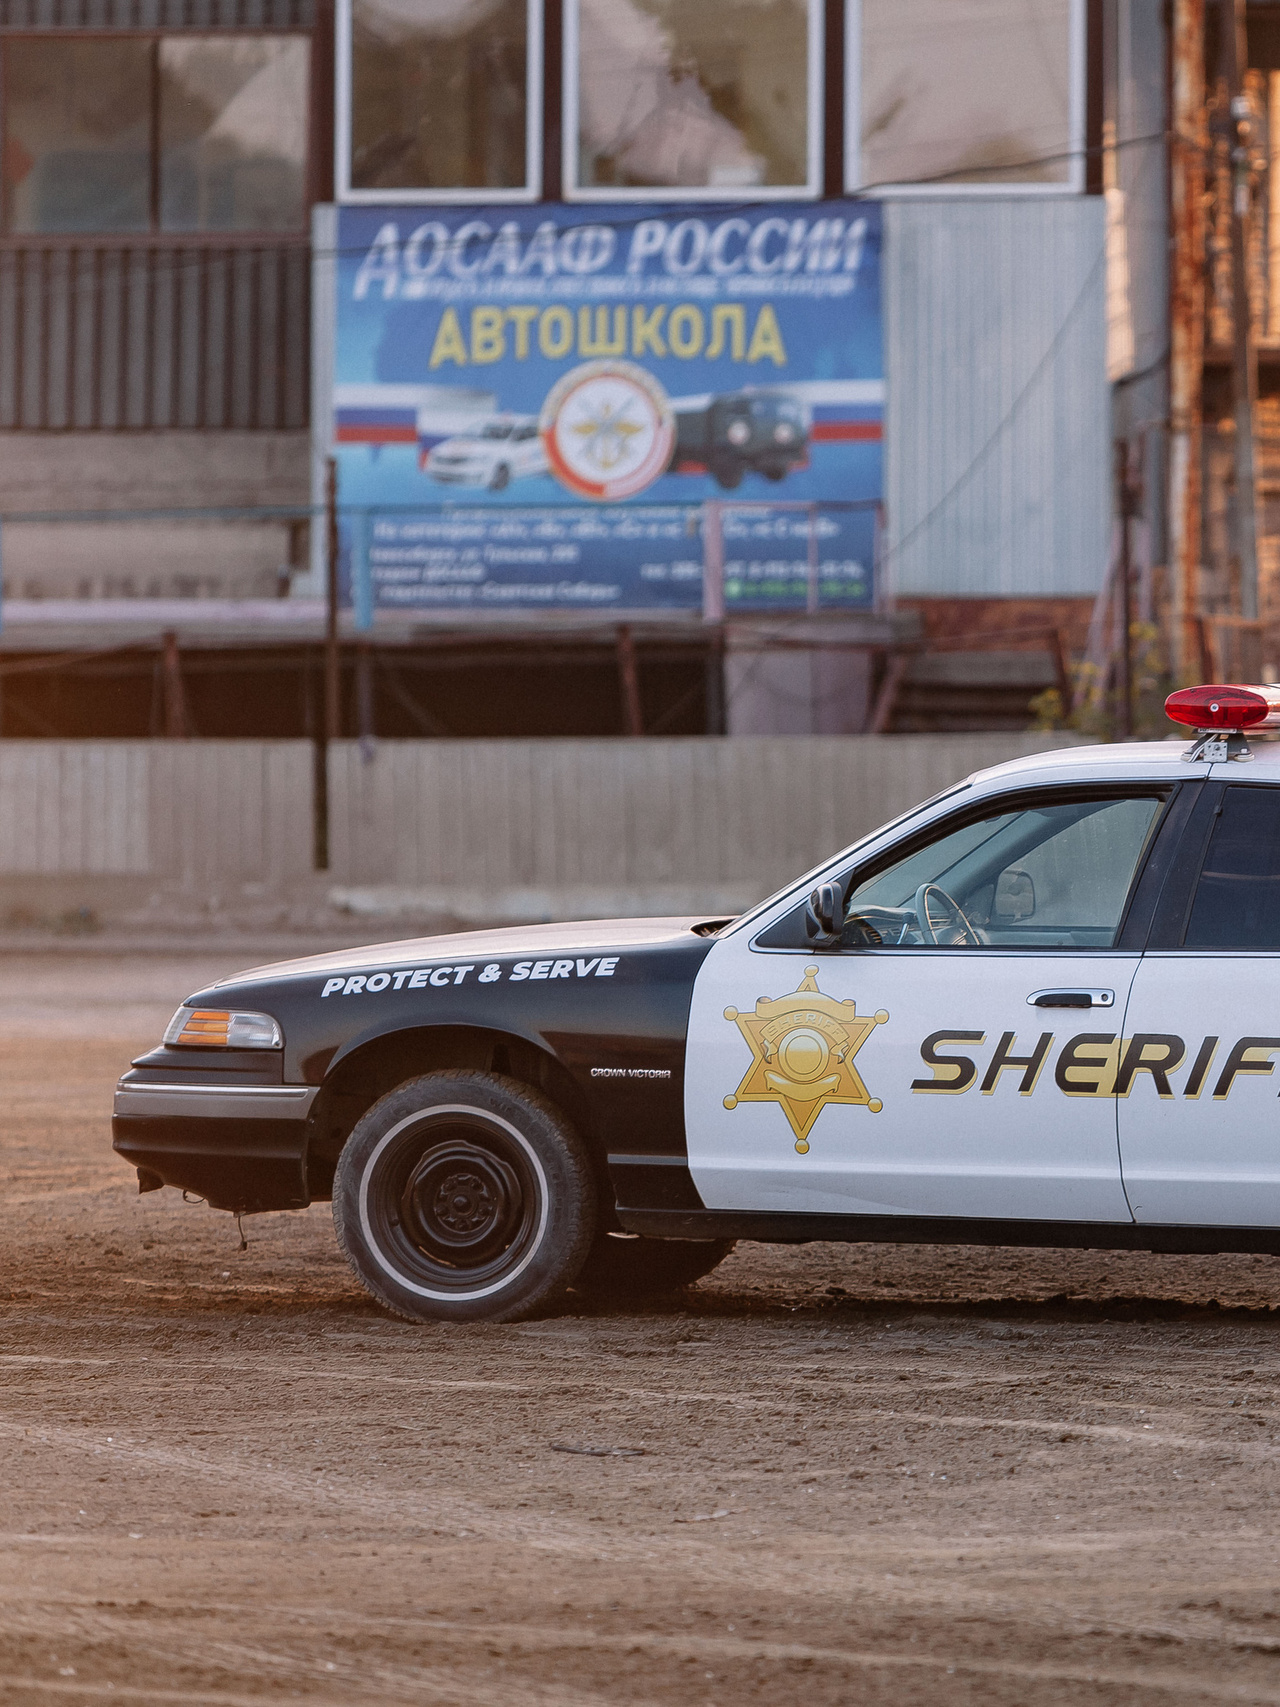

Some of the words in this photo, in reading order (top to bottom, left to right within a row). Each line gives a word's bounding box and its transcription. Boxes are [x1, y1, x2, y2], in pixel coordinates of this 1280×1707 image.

[352, 220, 618, 300] ДОСААФ
[626, 217, 869, 277] РОССИИ
[428, 302, 788, 369] АВТОШКОЛА
[321, 964, 476, 998] PROTECT
[479, 961, 501, 984] &
[508, 956, 620, 982] SERVE
[767, 1011, 844, 1037] SHERIFF
[590, 1067, 626, 1078] CROWN
[627, 1068, 672, 1079] VICTORIA
